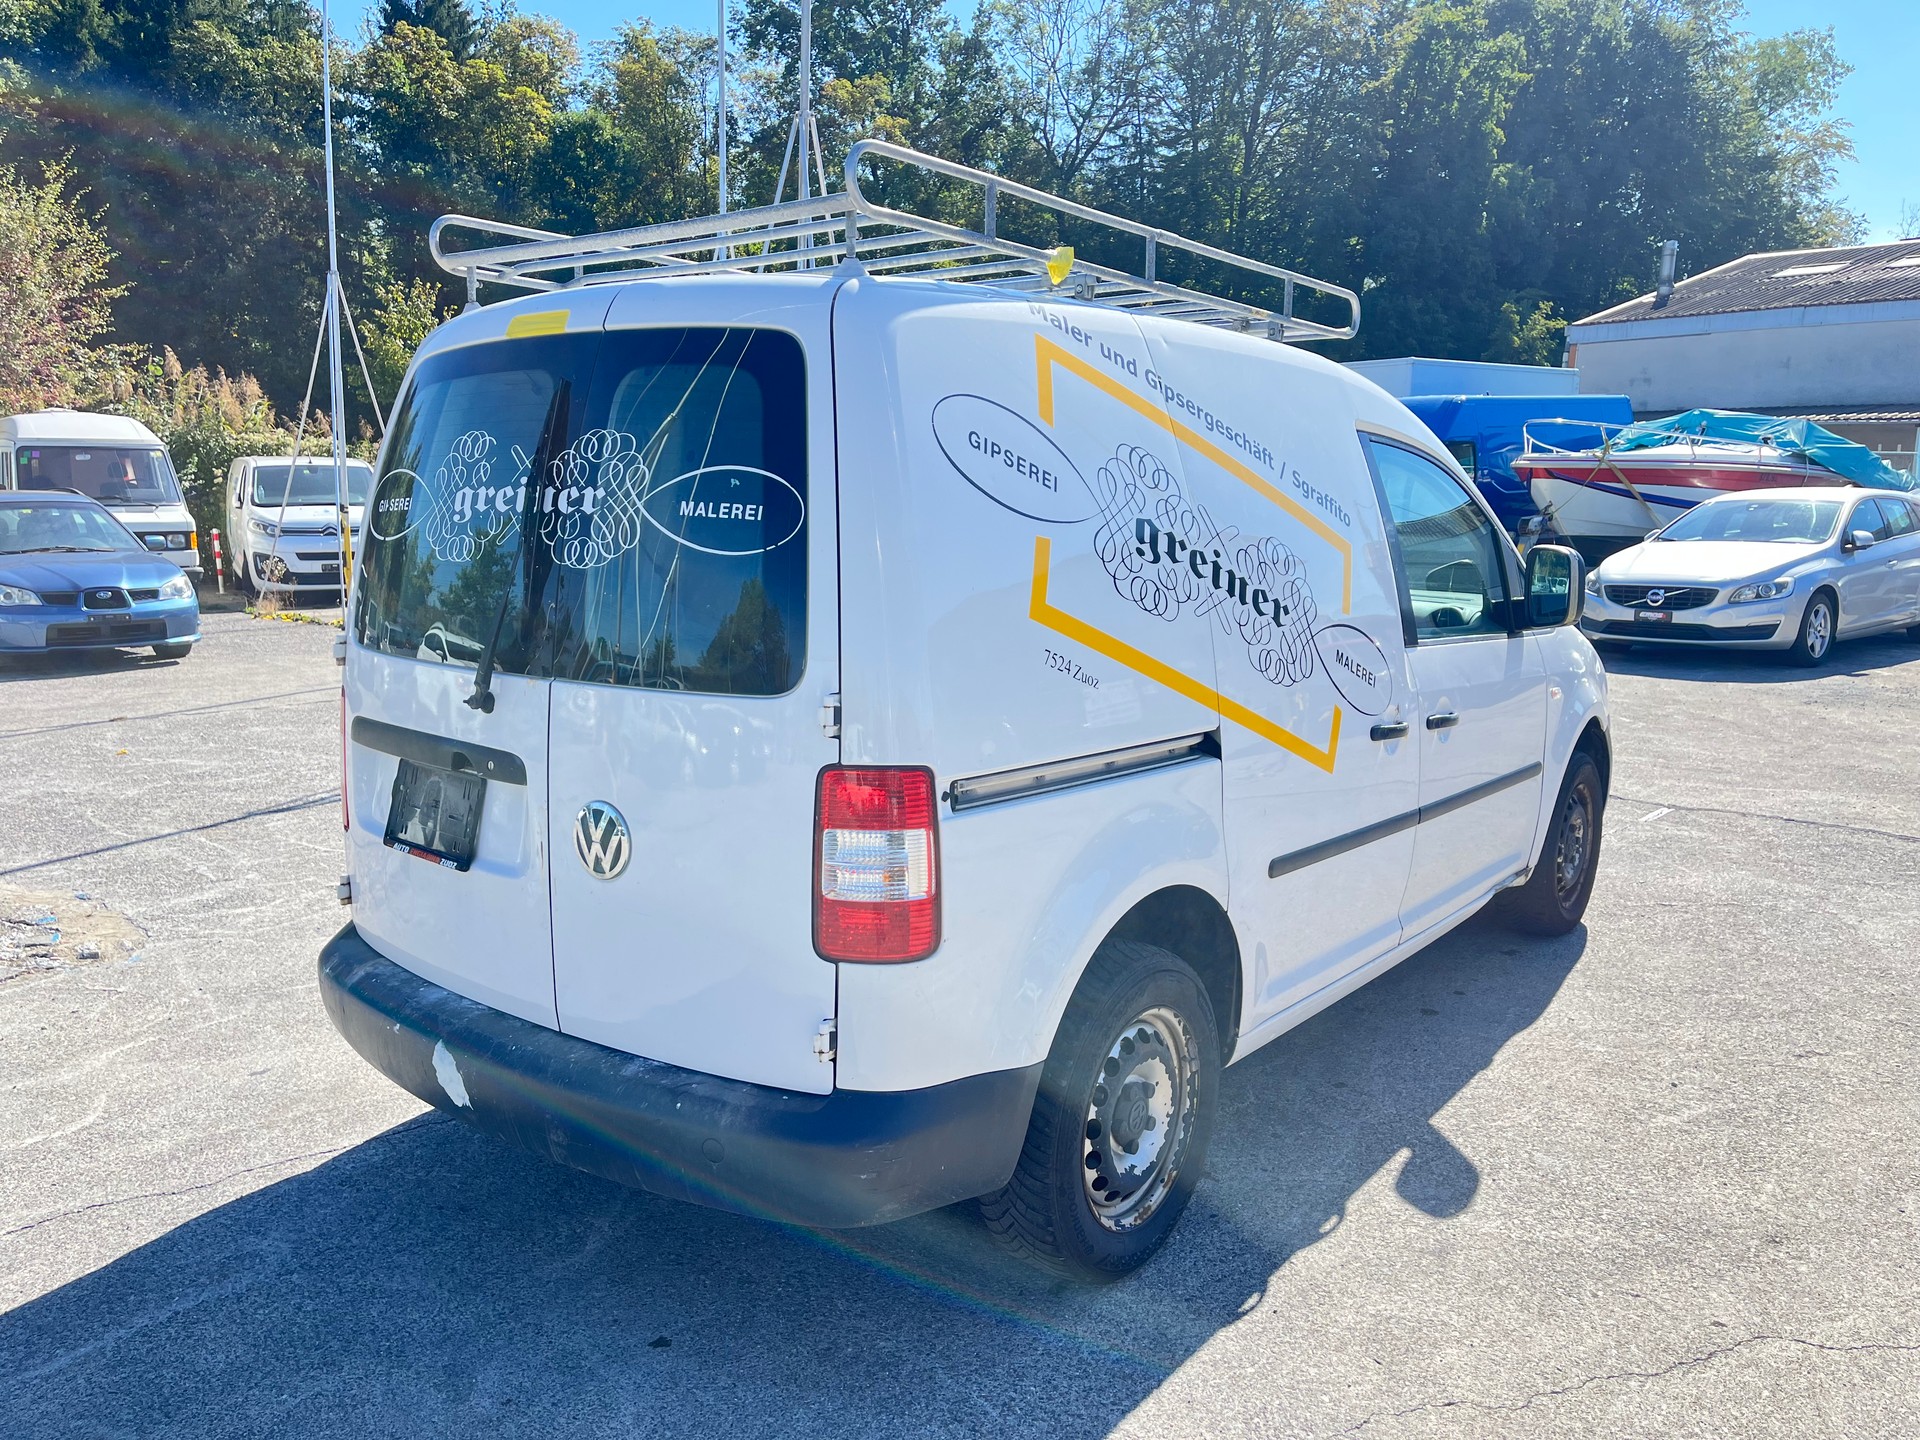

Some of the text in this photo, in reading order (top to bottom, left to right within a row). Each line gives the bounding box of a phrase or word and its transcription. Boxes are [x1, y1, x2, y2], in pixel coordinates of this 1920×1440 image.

[1027, 300, 1351, 527] Maler und Gipsergeschäft / Sgraffito
[968, 431, 1058, 493] GIPSEREI
[679, 500, 764, 521] MALEREI
[1135, 518, 1291, 627] greiner
[1044, 649, 1099, 689] 7524 Zuoz
[1335, 649, 1377, 689] MALEREI
[393, 843, 409, 853] AUTO
[440, 859, 457, 869] ZUOZ
[574, 801, 631, 880] VW
